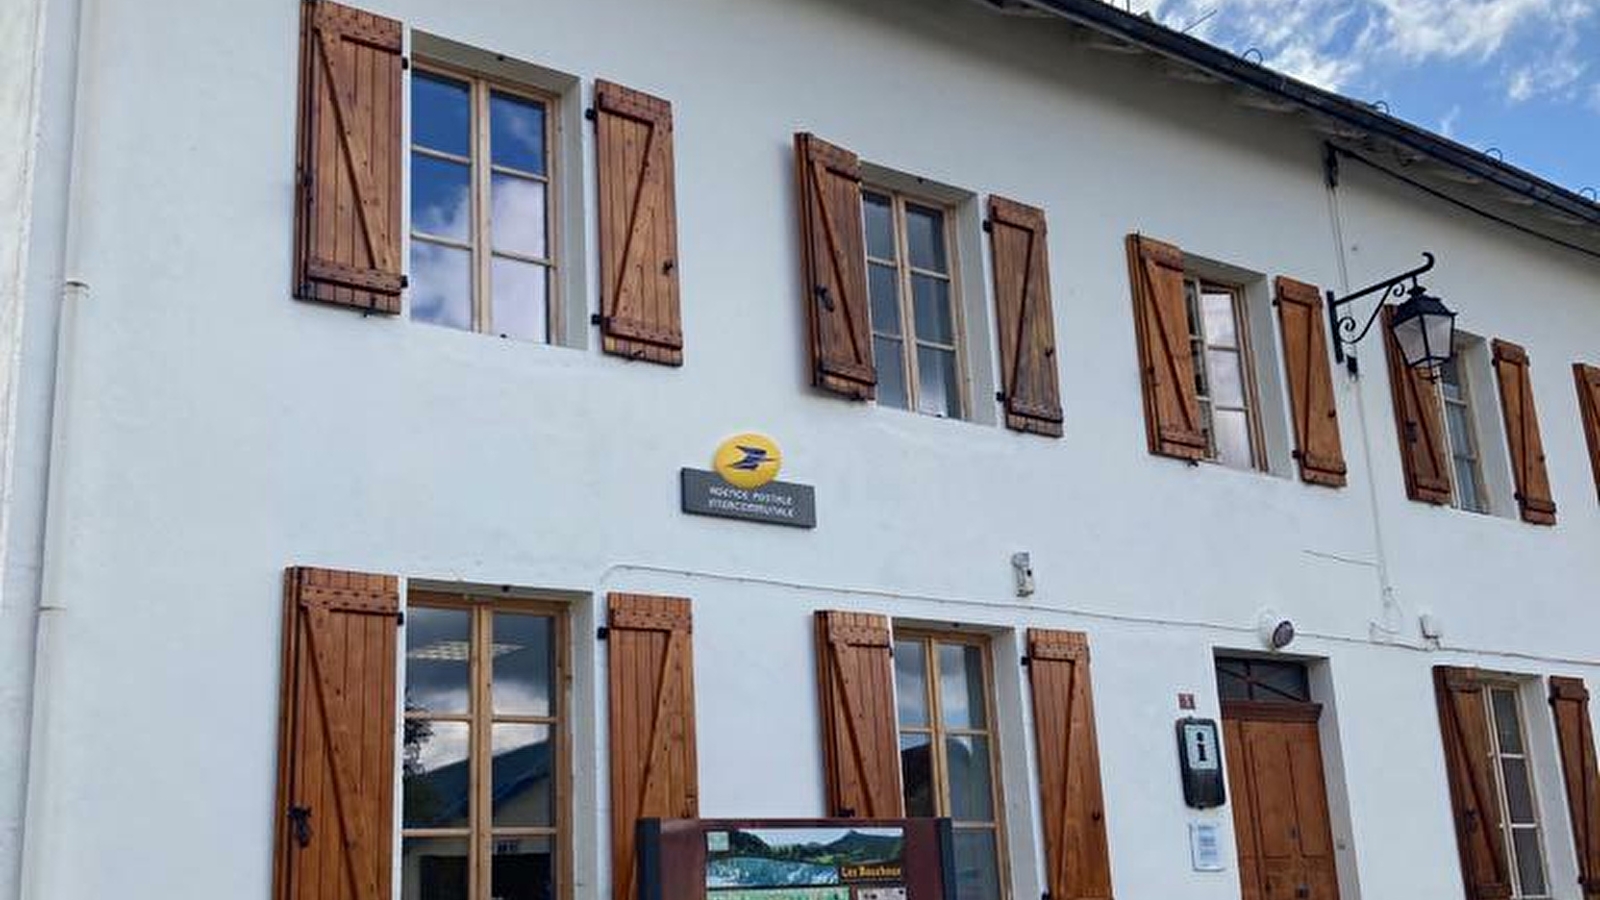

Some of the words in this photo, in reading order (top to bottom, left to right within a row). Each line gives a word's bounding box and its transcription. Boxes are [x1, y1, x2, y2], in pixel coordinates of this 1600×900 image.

[709, 486, 749, 500] AGENCE
[753, 492, 793, 506] POSTALE
[708, 498, 795, 518] INTERCOMMUNALE
